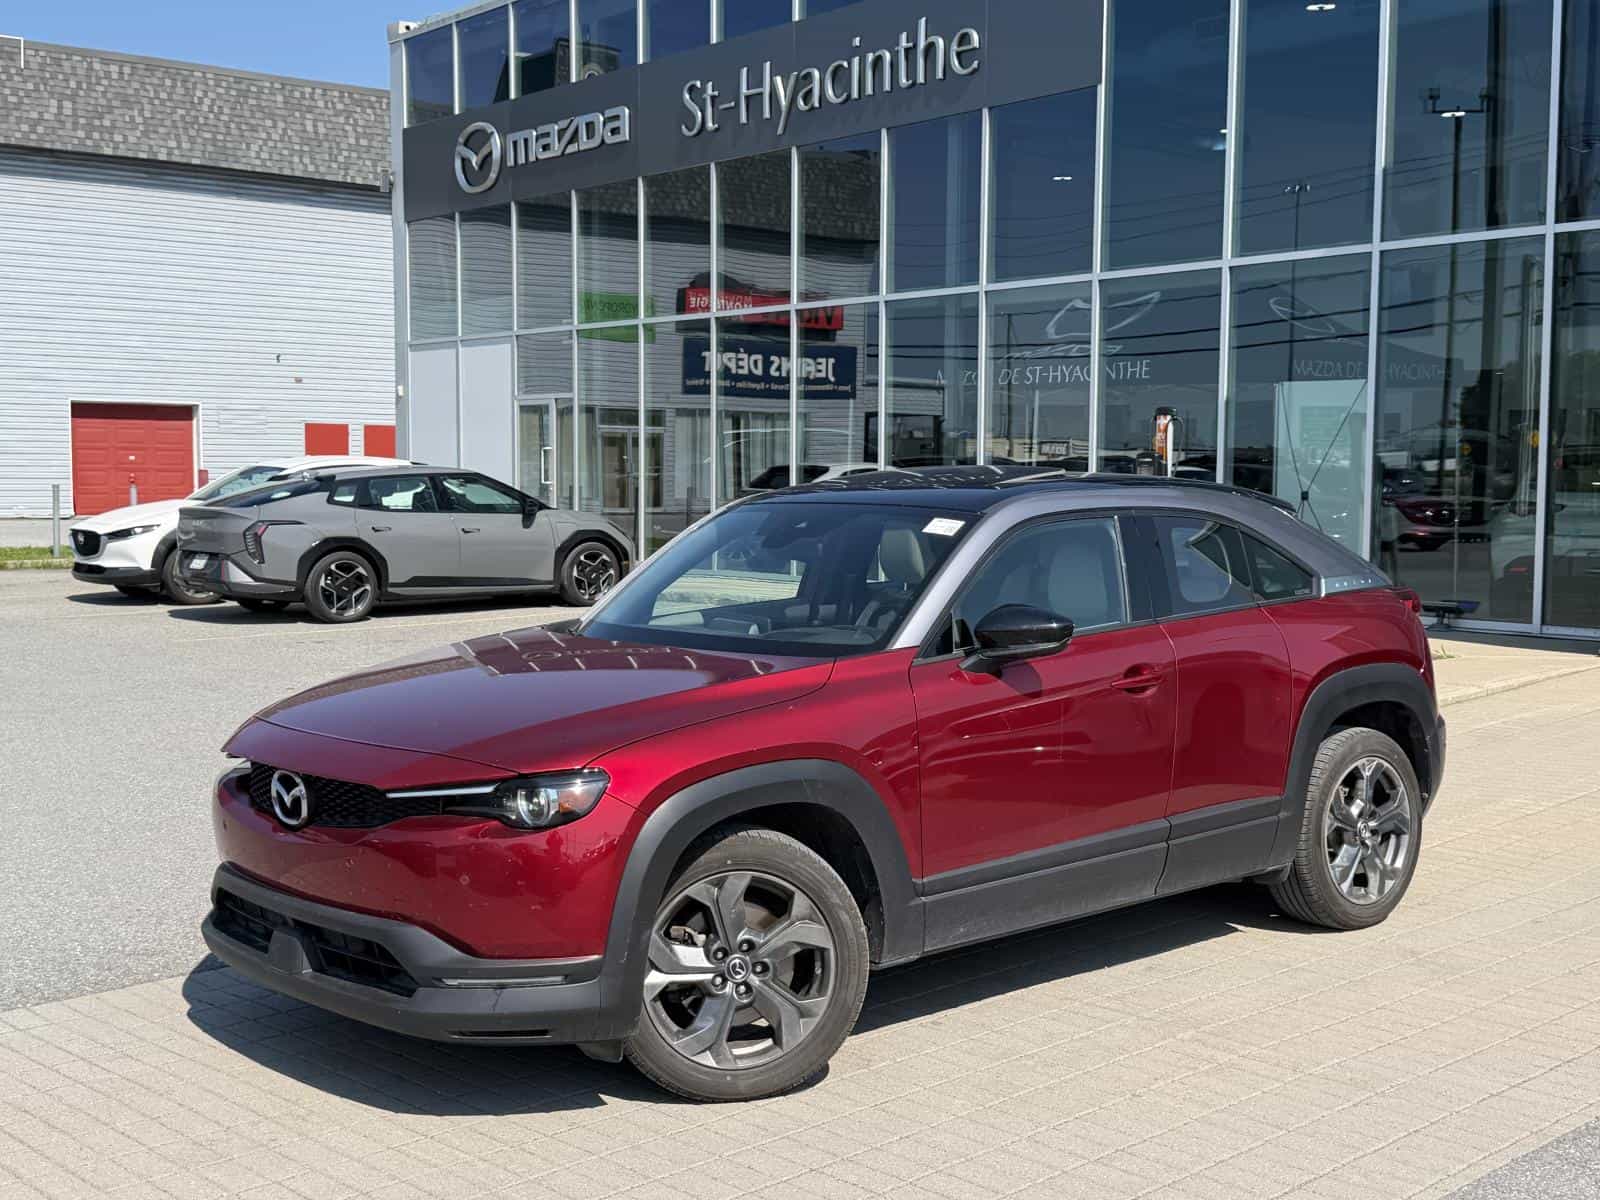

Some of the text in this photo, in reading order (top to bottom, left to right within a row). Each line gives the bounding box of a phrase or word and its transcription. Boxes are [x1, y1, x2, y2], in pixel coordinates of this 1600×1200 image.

[680, 16, 980, 137] St-Hyacinthe
[998, 367, 1021, 385] DE
[1024, 359, 1151, 385] ST-HYACNTHE
